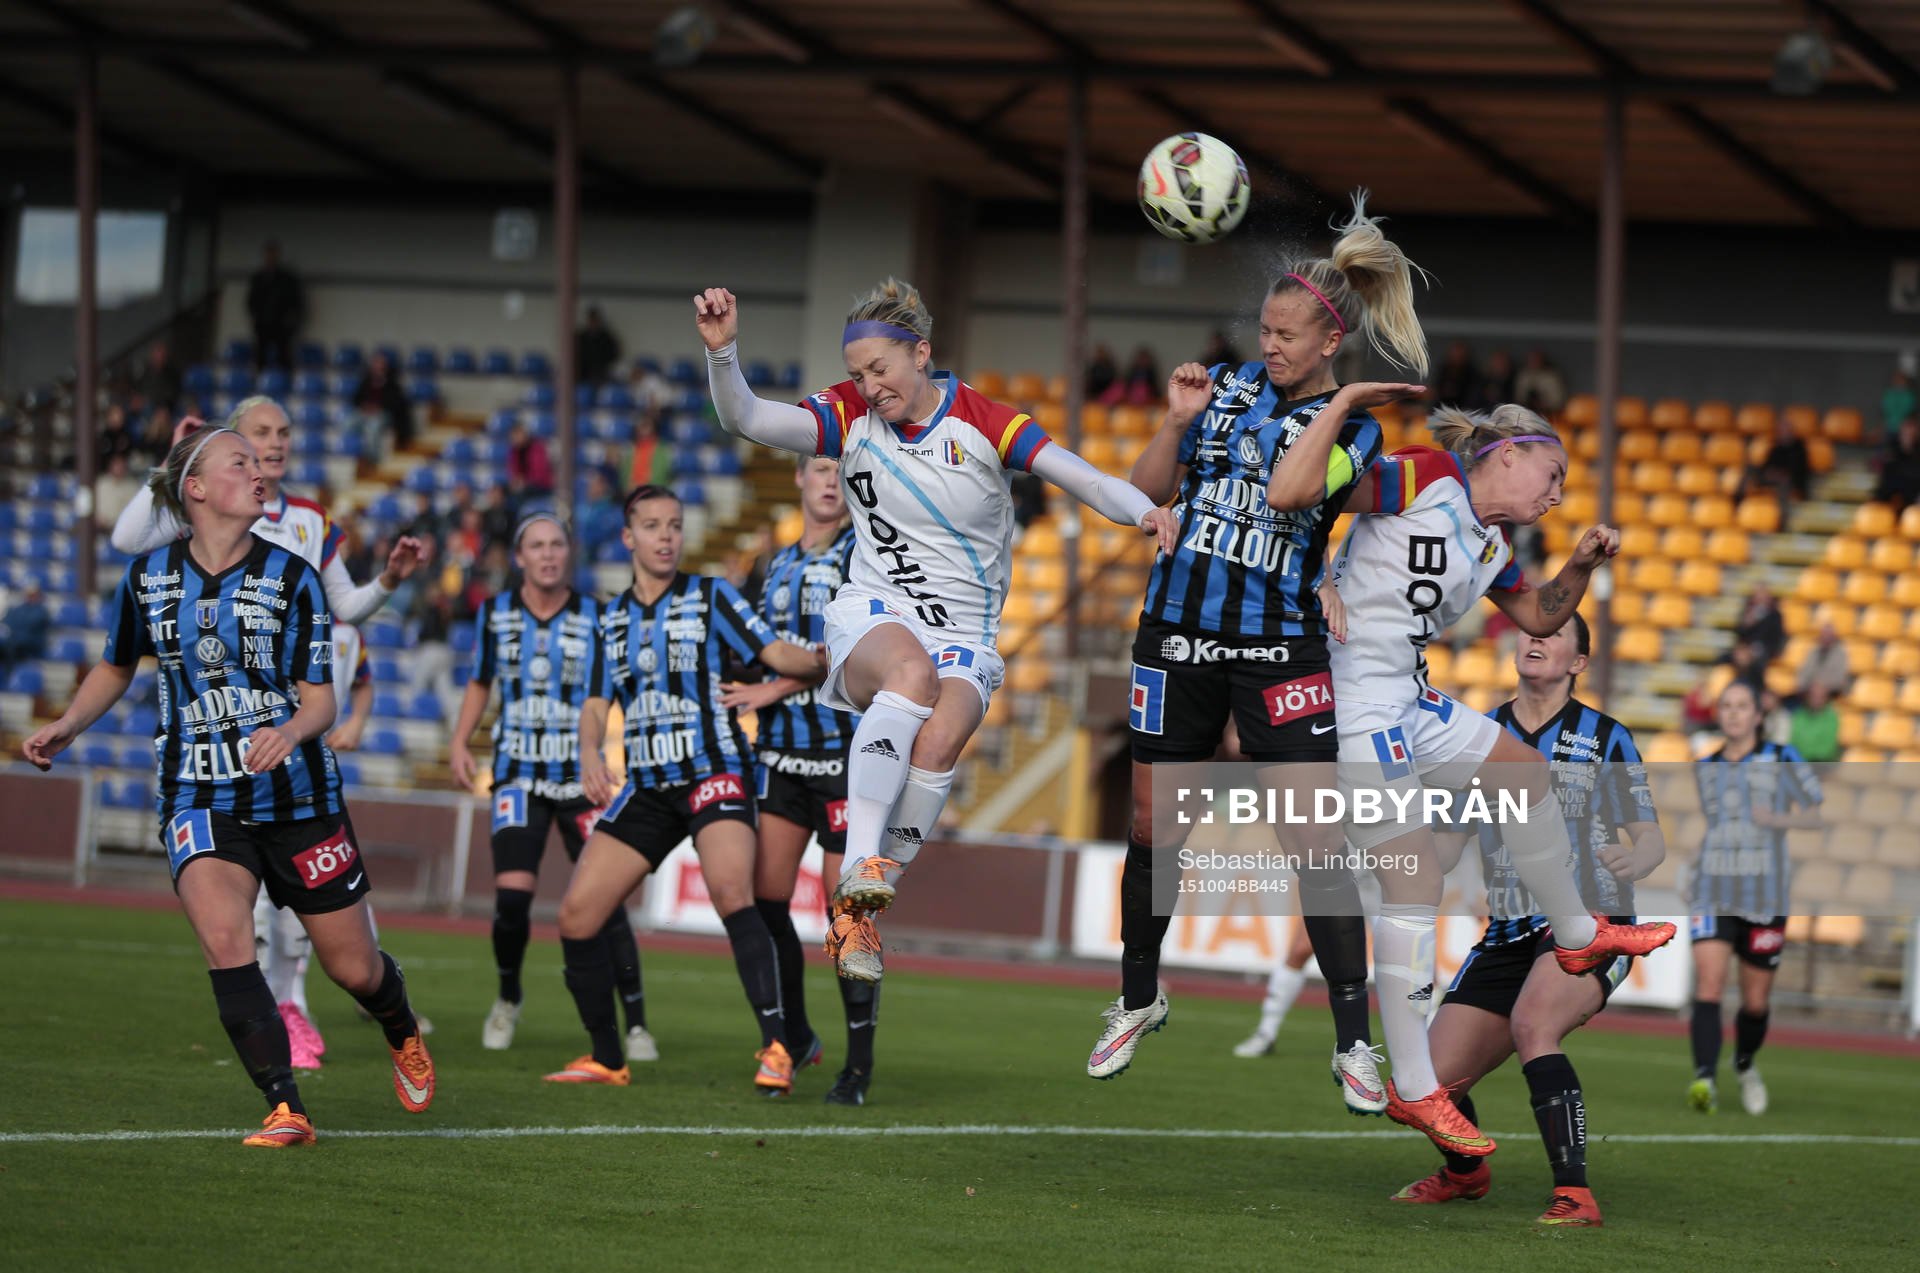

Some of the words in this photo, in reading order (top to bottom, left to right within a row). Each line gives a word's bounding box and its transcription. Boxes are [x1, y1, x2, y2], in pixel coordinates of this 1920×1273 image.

[1184, 515, 1303, 577] ZELLOUT
[140, 569, 181, 588] Upplands
[243, 574, 286, 592] Upplands
[232, 588, 288, 610] Brandservice
[243, 635, 274, 653] NOVA
[1192, 637, 1290, 665] Koneo
[244, 652, 277, 669] PARK
[1274, 683, 1333, 718] JÖTA
[1560, 729, 1601, 750] Upplands
[861, 744, 900, 762] adidas
[1551, 741, 1603, 765] Brandservice
[776, 754, 845, 777] Koneo
[692, 776, 741, 806] JÖTA
[1555, 787, 1587, 804] NOVA
[1562, 803, 1585, 818] ARK
[888, 826, 924, 846] adidas
[308, 845, 354, 882] JÖTA
